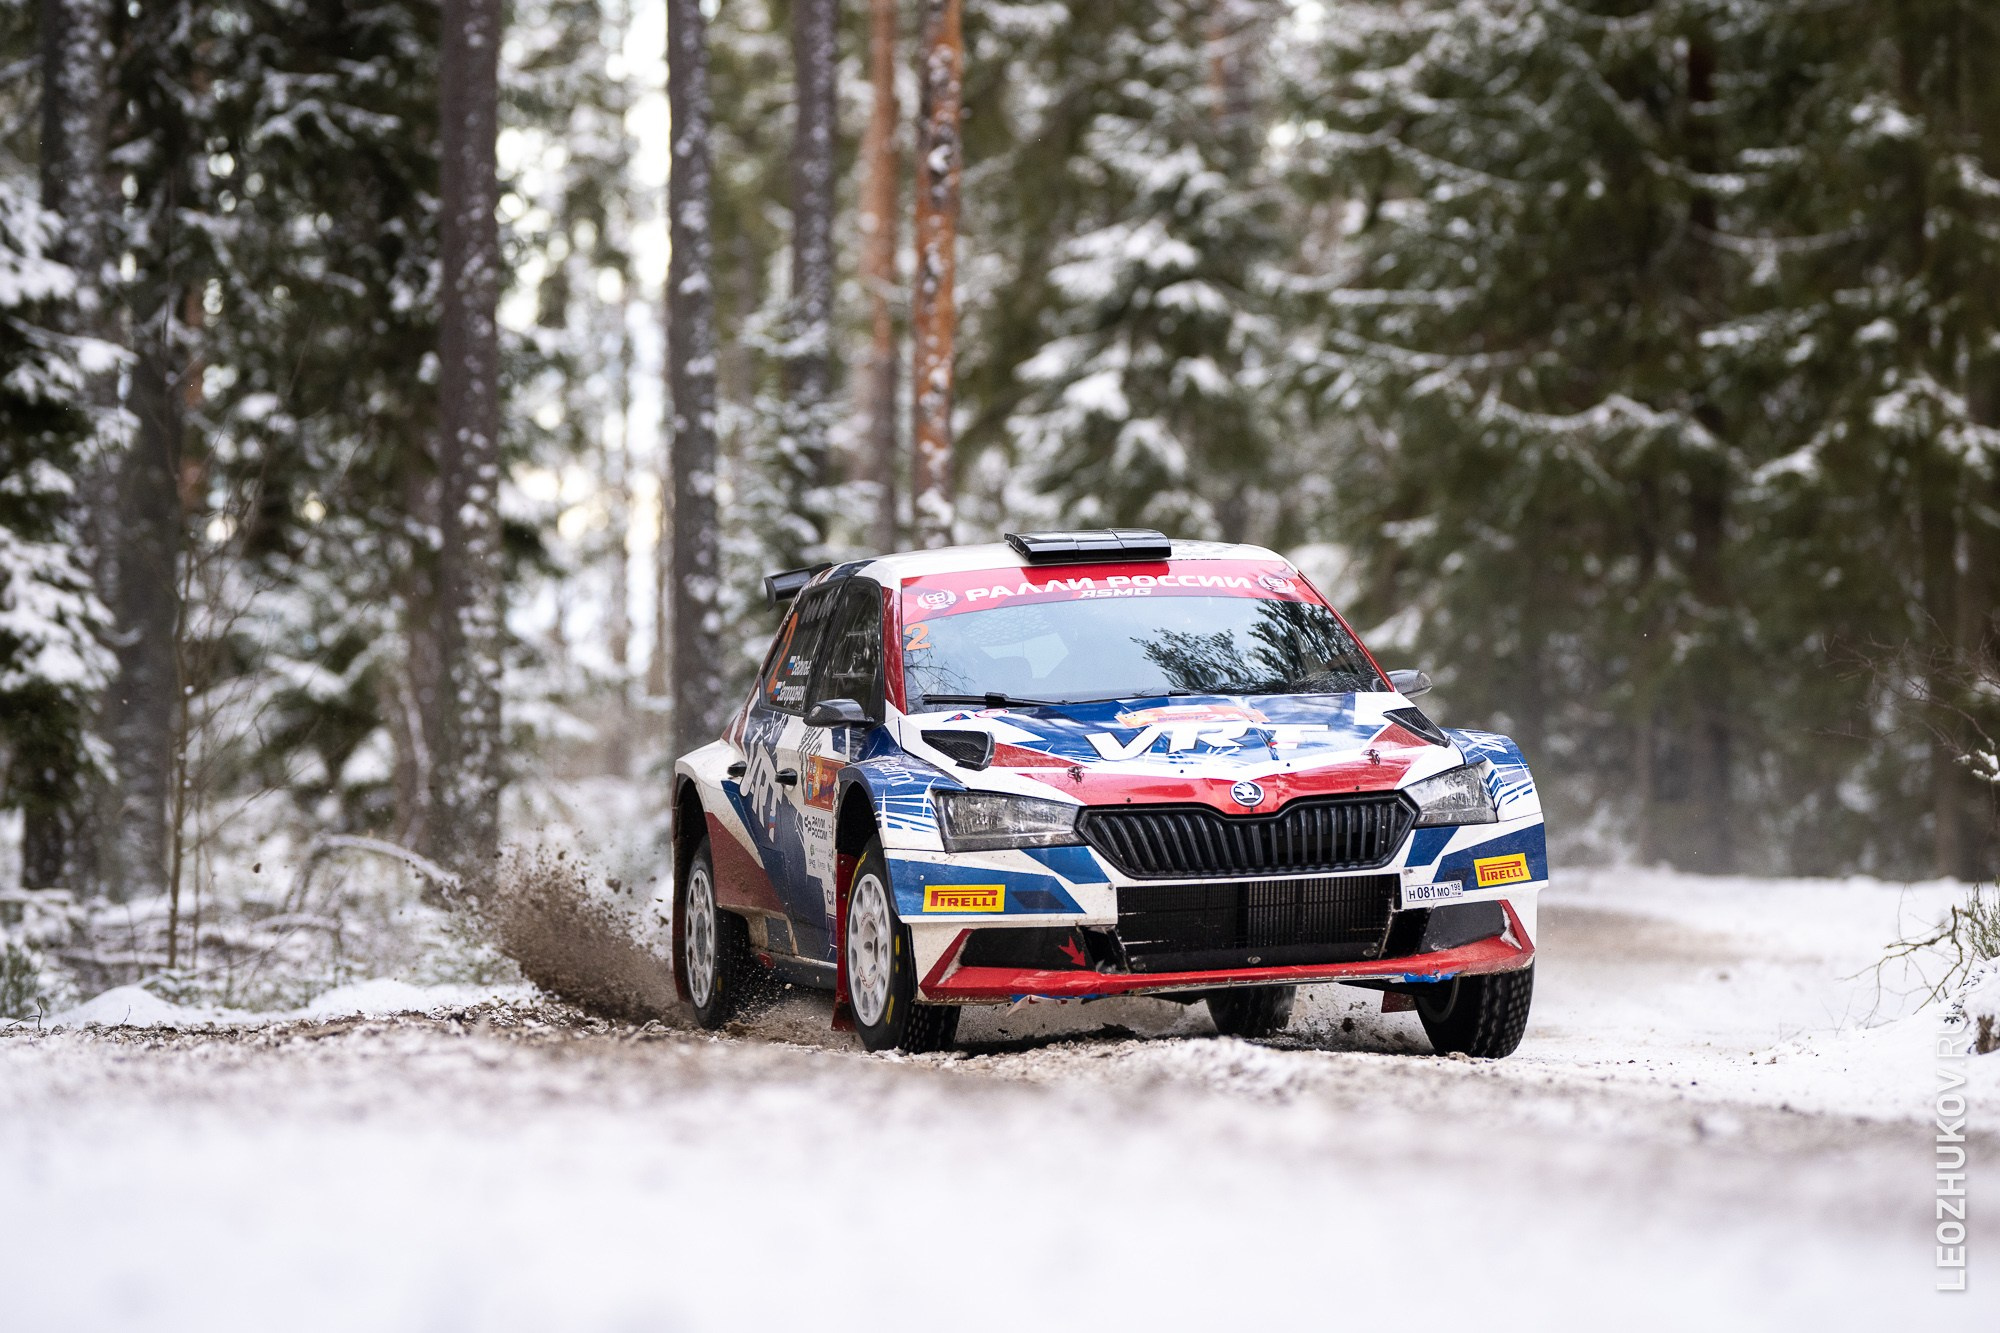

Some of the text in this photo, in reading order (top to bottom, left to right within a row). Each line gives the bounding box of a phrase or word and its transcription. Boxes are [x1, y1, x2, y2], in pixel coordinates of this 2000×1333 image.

[965, 577, 1096, 602] РАЛЛИ
[1106, 575, 1253, 589] РОССИИ
[904, 623, 931, 651] 2
[1083, 722, 1329, 762] VRT
[1479, 861, 1524, 882] PIRELLI
[930, 889, 998, 907] PIRELLI
